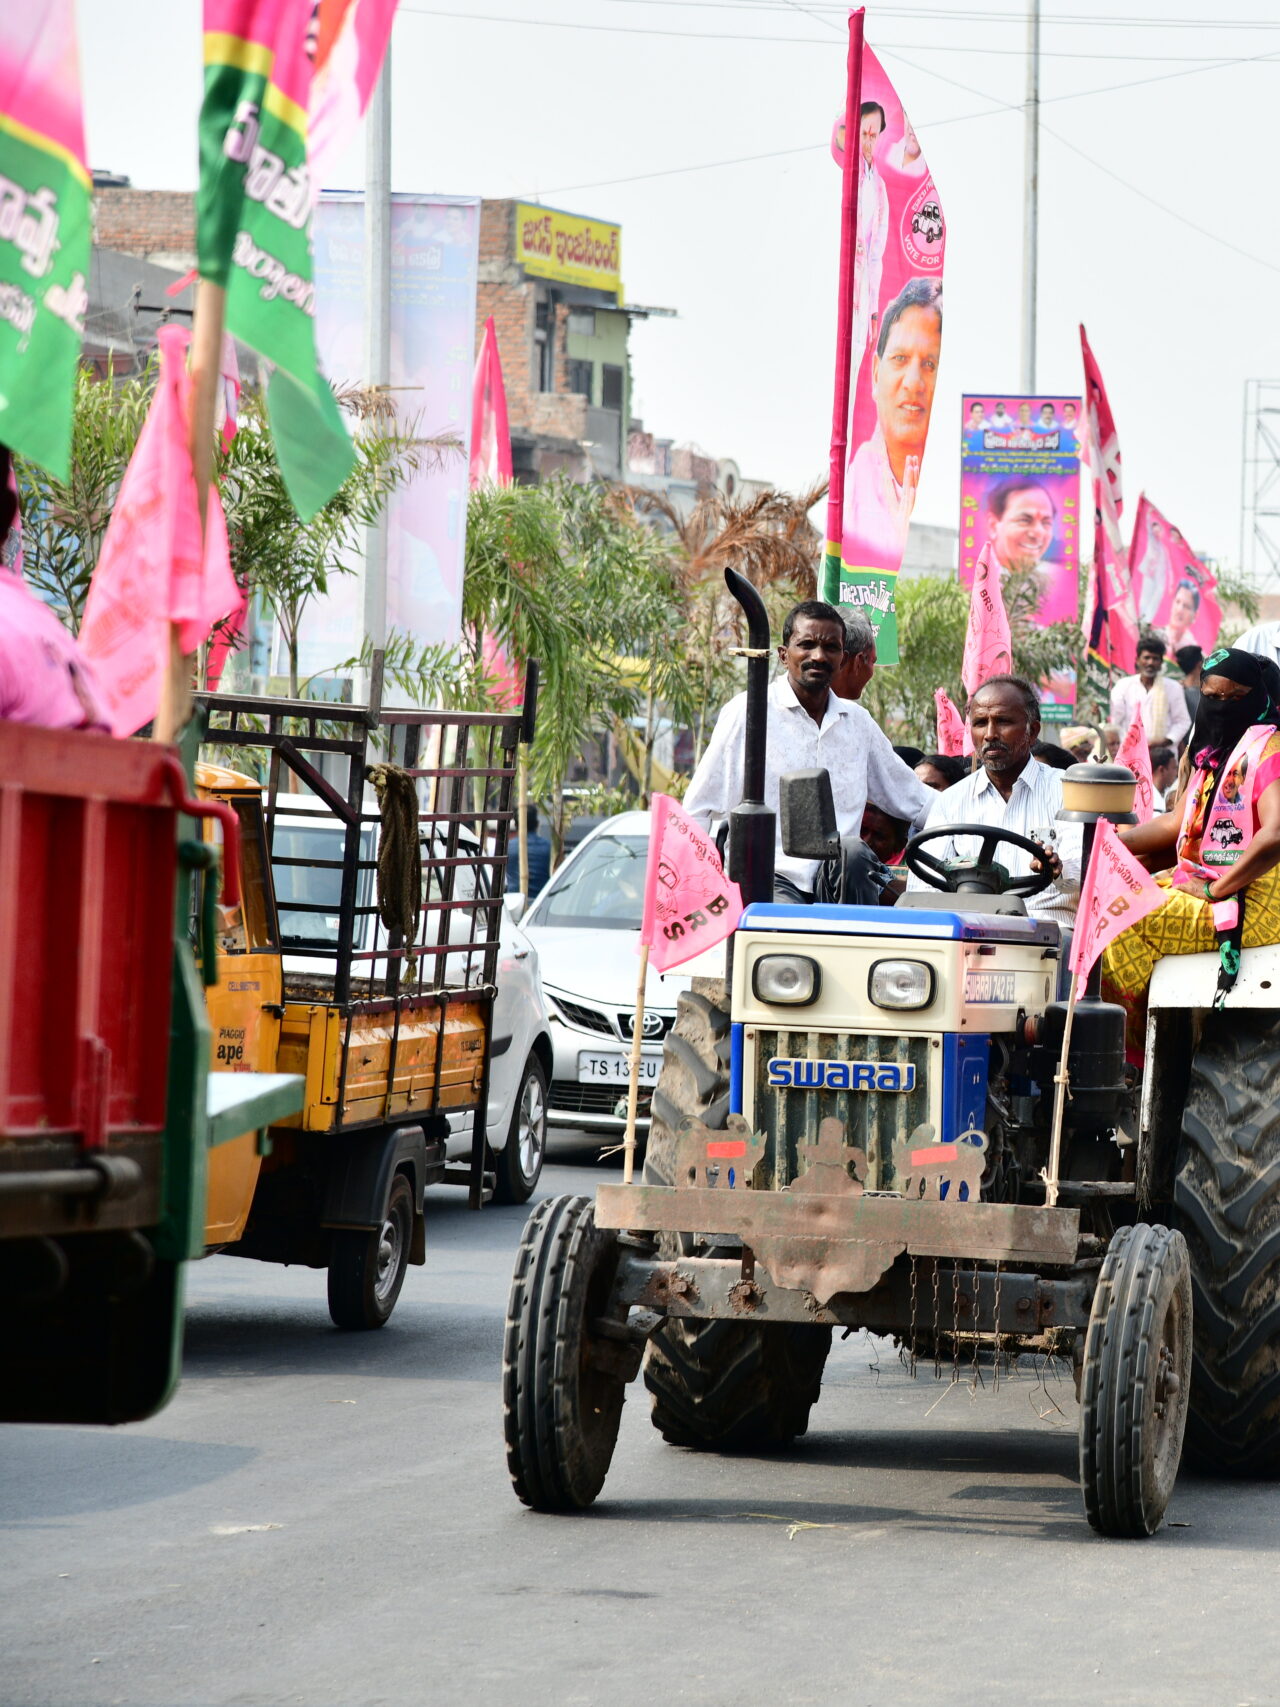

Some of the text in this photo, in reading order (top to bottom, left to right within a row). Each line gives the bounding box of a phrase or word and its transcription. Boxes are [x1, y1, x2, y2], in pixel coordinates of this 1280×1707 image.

[904, 234, 940, 265] VOTE FOR
[979, 588, 994, 613] BRS
[663, 894, 729, 942] BRS
[1095, 896, 1131, 939] BR
[219, 1028, 246, 1040] PIAGGIO
[217, 1041, 244, 1065] apé
[589, 1059, 656, 1078] TS 13 EU
